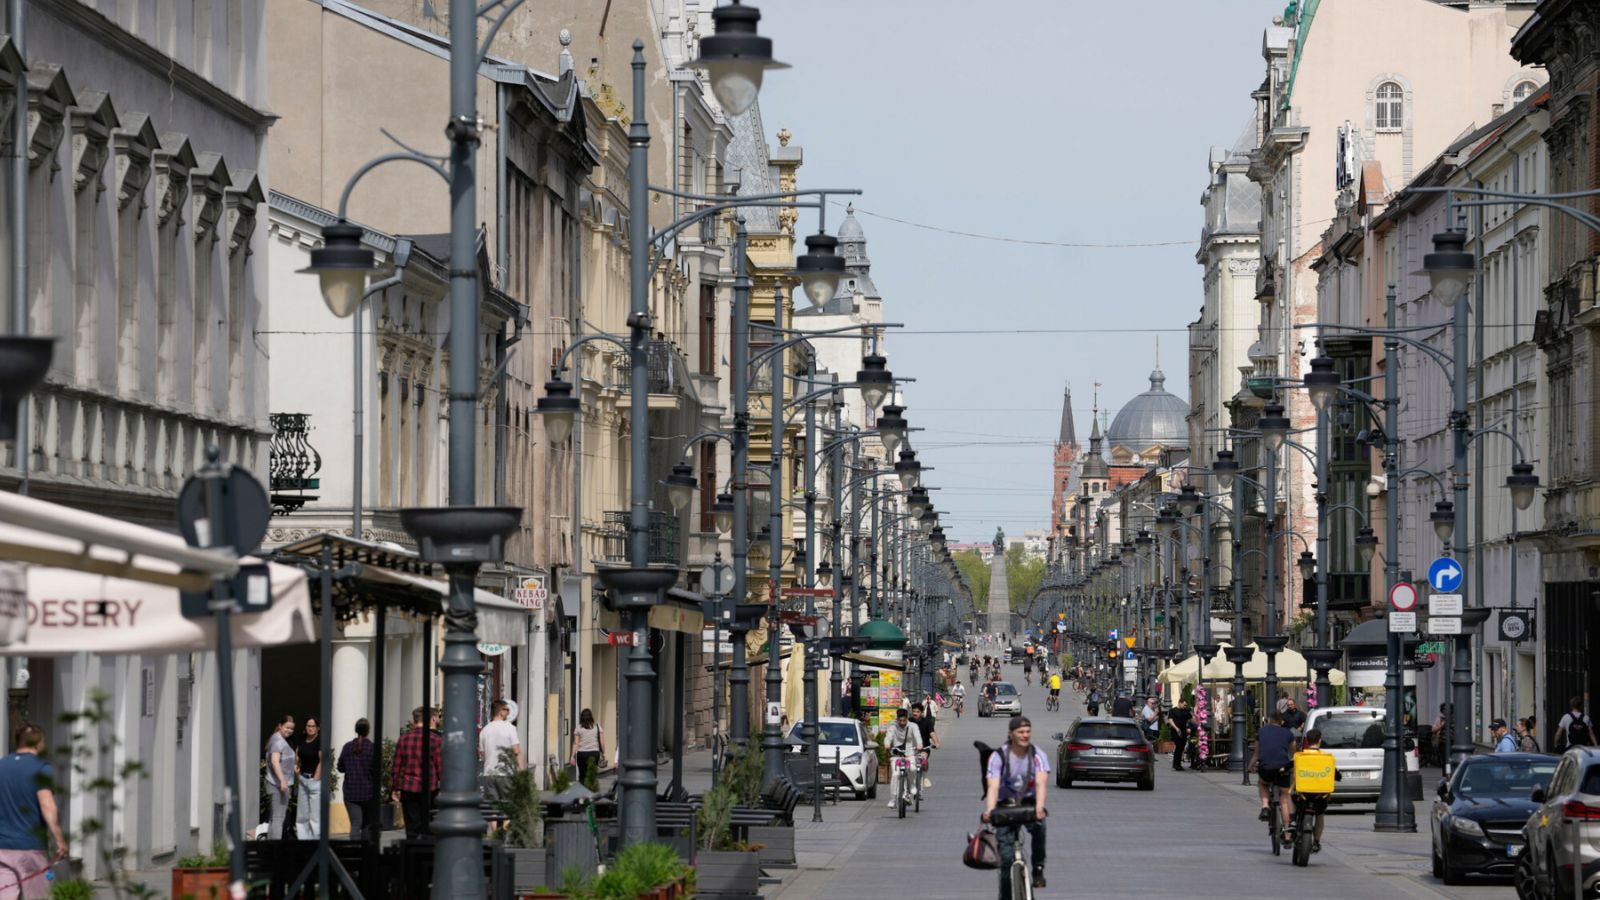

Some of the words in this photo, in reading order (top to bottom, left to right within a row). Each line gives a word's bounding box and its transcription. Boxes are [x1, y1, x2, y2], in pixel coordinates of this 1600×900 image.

[516, 589, 546, 598] KEBAB
[519, 599, 540, 607] KING
[616, 634, 631, 644] WC
